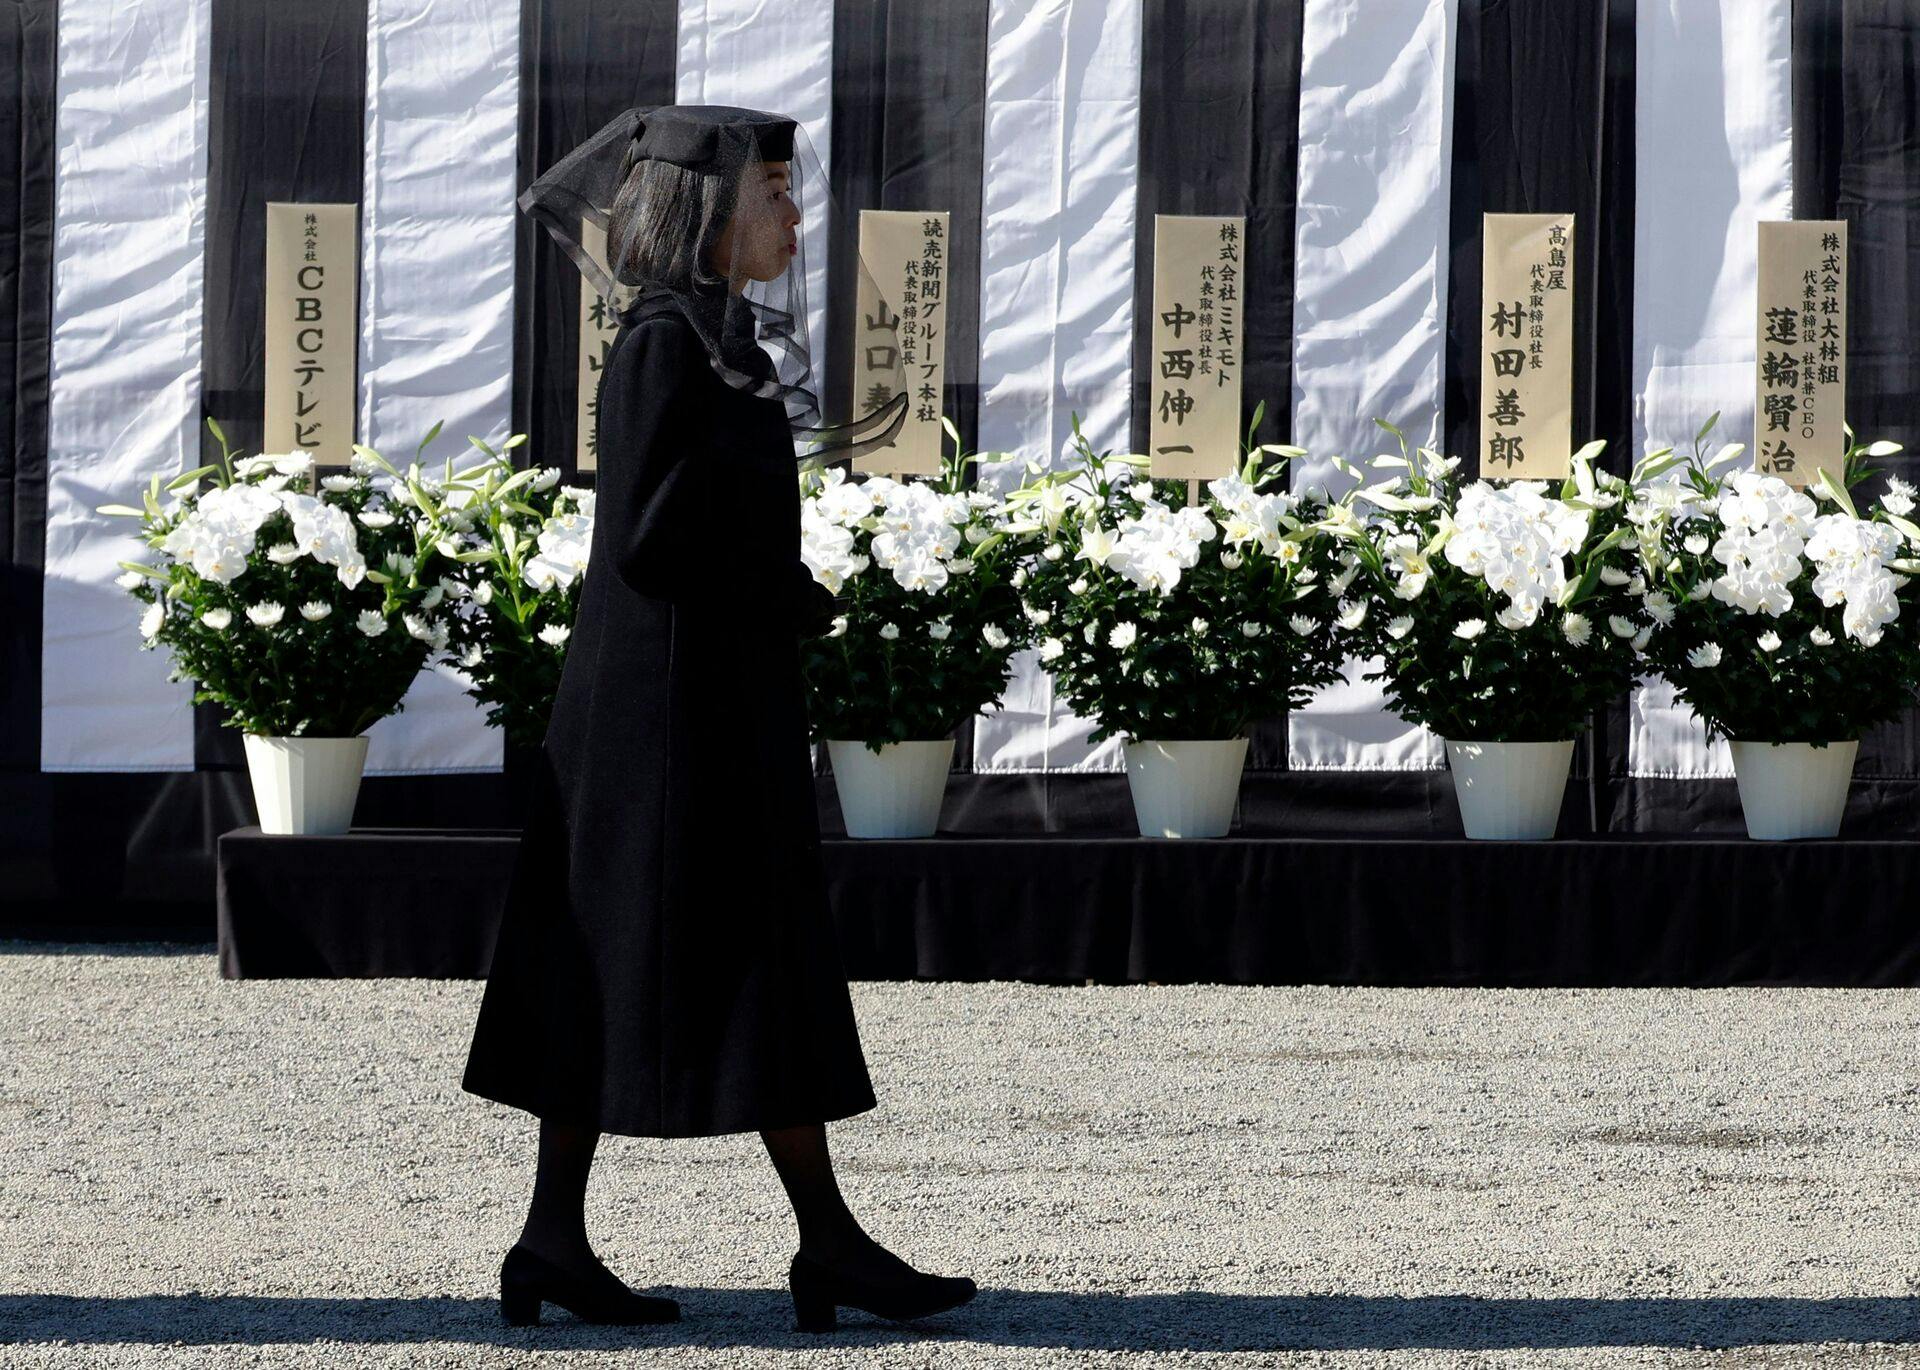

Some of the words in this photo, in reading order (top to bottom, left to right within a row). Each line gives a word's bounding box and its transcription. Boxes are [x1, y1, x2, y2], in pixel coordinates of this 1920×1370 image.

[902, 260, 919, 365] 代表取締役社長
[916, 218, 944, 423] 読売新聞グループ本社
[1156, 302, 1196, 455] 中西伸一
[1198, 265, 1215, 375] 代表取締役社長
[1215, 223, 1238, 388] 株式会社ミキモト
[1528, 264, 1544, 369] 代表取締役社長
[1818, 232, 1841, 384] 株式会社大林組
[1487, 301, 1527, 470] 村田善郎
[1761, 307, 1800, 474] 蓮輪賢治
